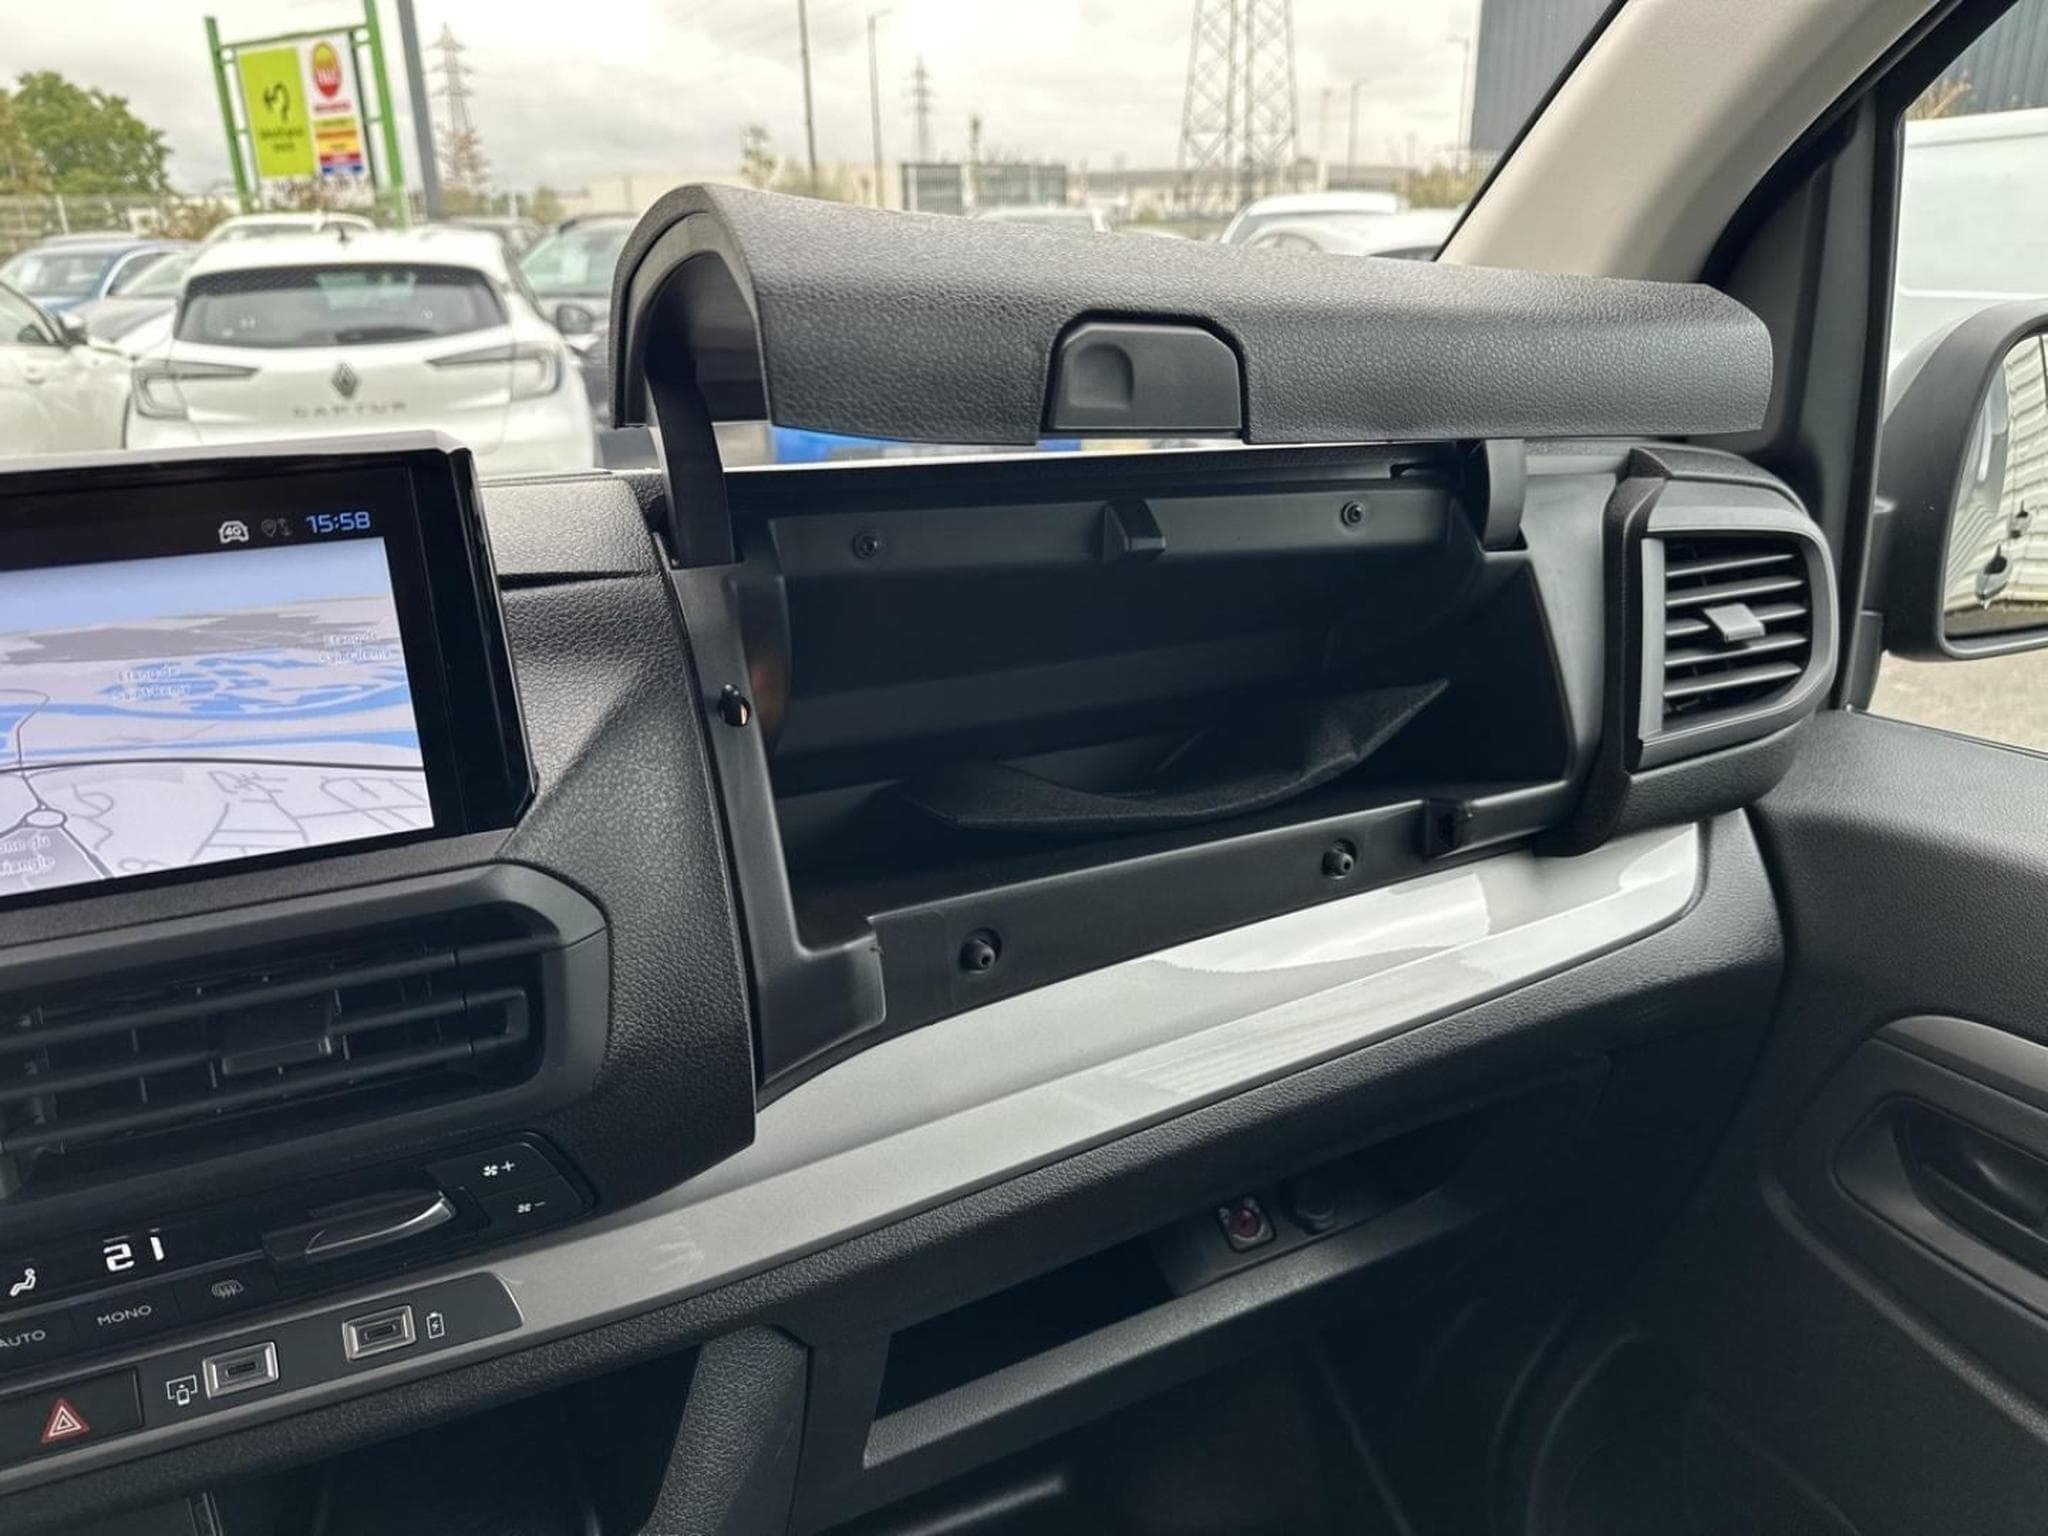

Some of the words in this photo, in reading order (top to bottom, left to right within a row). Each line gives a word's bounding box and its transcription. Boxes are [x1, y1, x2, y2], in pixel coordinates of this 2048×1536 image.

[225, 526, 242, 536] 4G
[306, 511, 371, 534] 15:58
[97, 1304, 152, 1326] MONO
